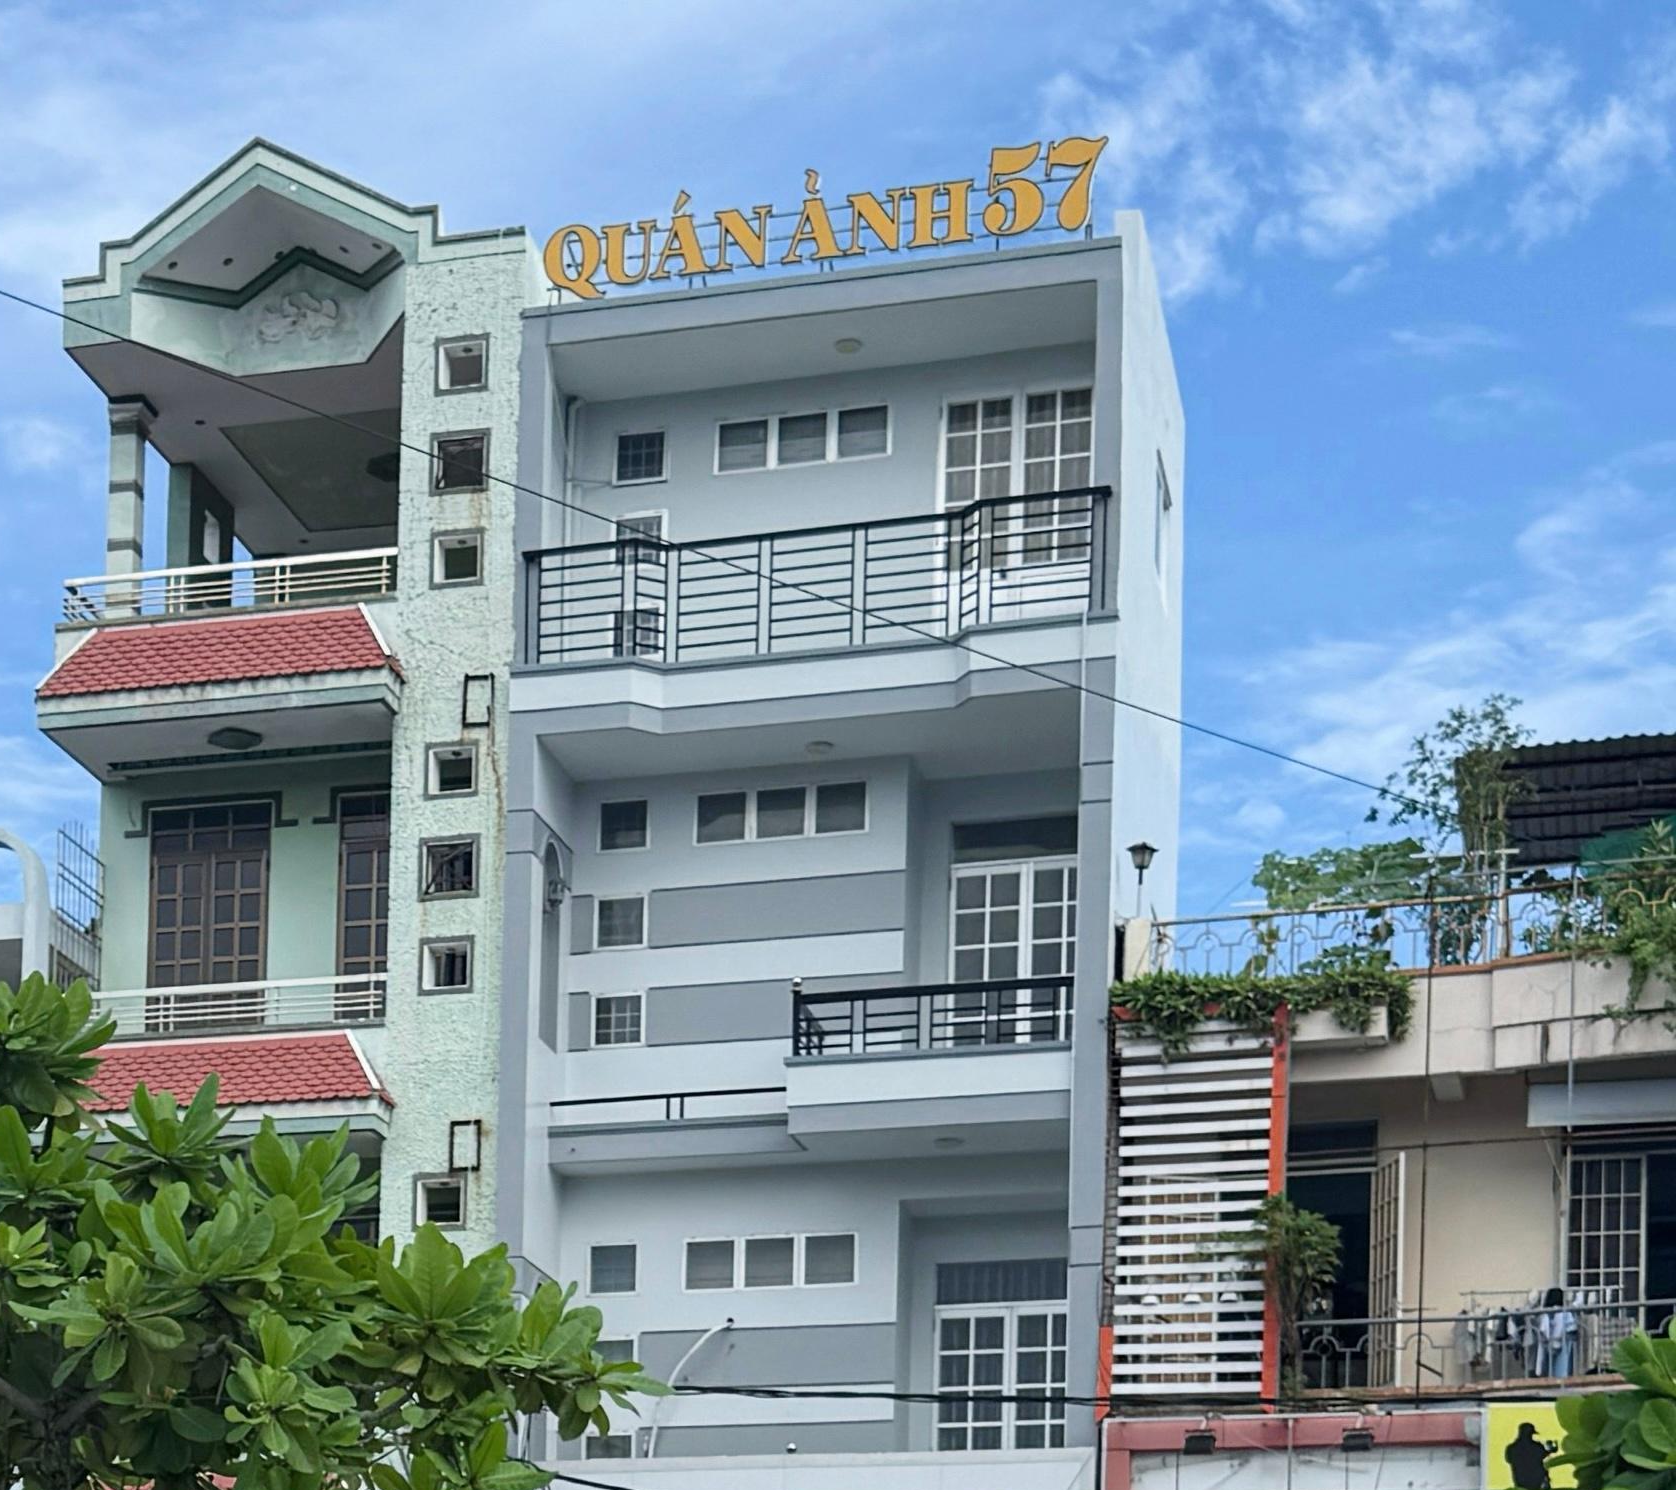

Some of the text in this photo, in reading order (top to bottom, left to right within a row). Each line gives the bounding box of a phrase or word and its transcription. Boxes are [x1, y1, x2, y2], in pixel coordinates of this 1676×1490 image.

[542, 135, 1110, 300] QUÁN ẢNH 57
